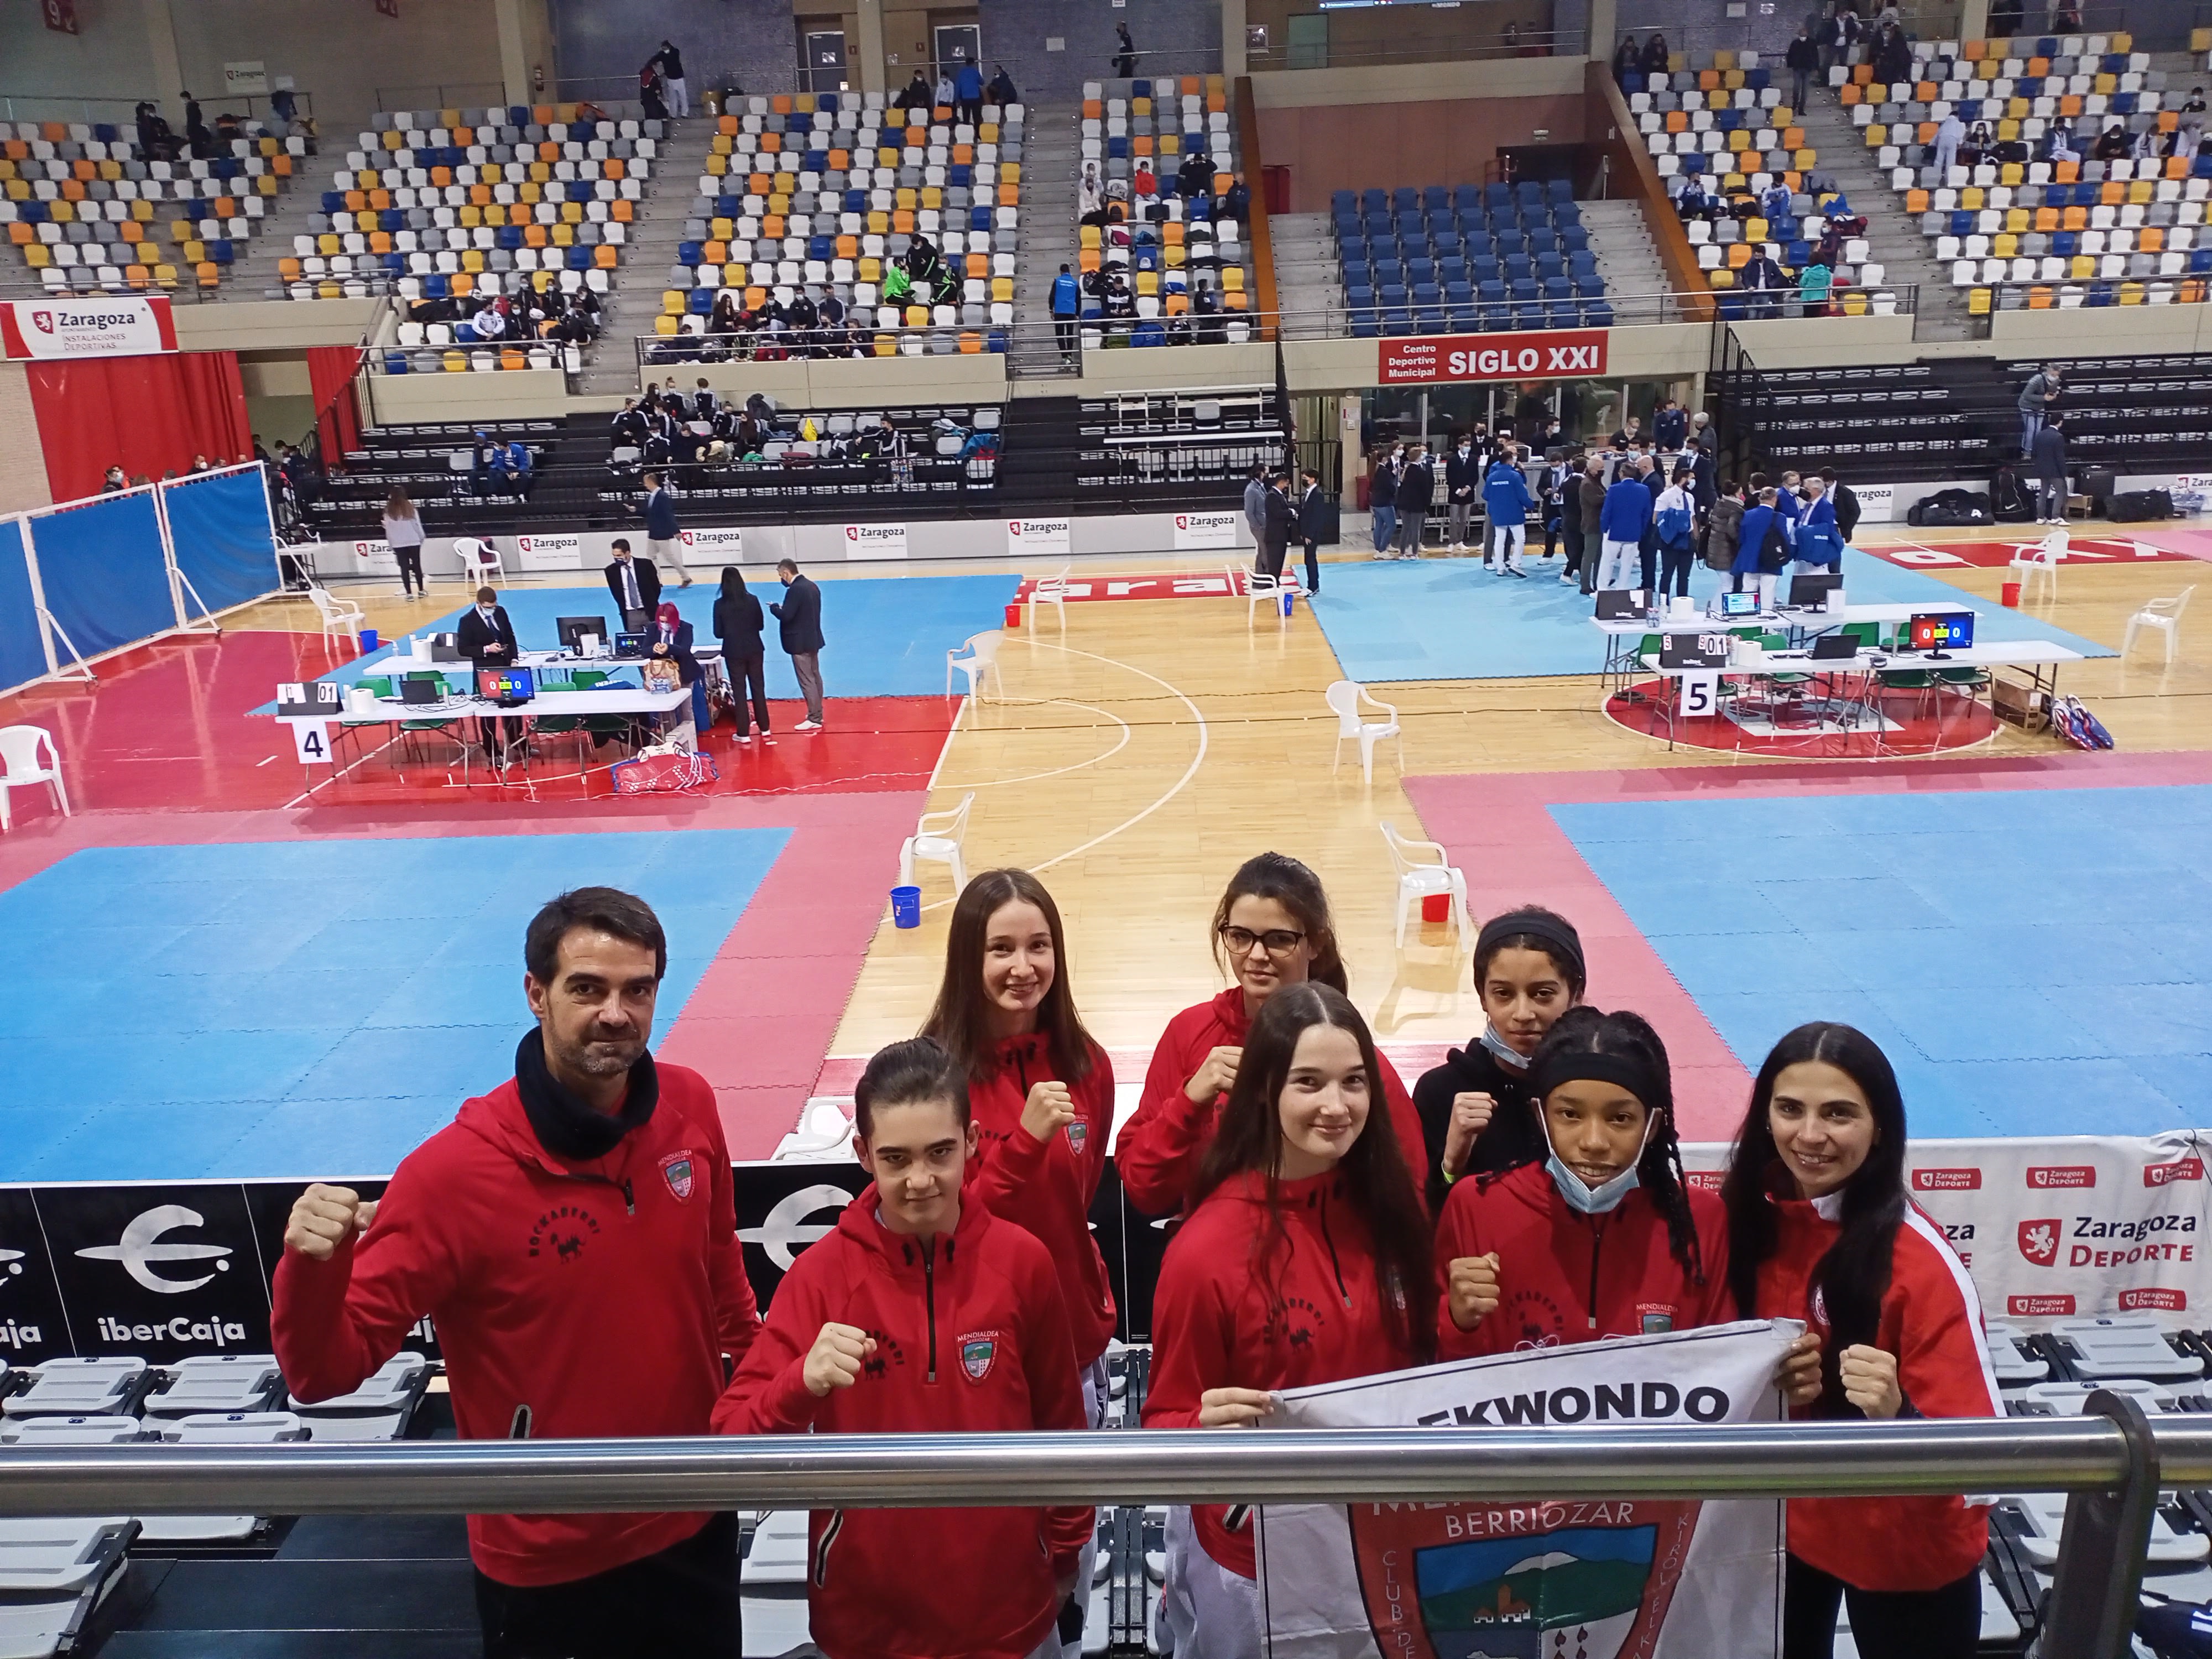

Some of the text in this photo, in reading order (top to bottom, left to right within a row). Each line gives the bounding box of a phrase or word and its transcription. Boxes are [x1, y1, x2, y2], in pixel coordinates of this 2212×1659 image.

[58, 312, 135, 330] Zaragoza
[62, 333, 126, 342] INSTALACIONES
[64, 342, 117, 351] DEPORTIVAS
[1403, 345, 1436, 354] Centro
[1389, 356, 1436, 367] Deportivo
[1448, 345, 1599, 375] SIGLO XXI
[1389, 367, 1436, 378] Municipal
[1853, 490, 1891, 501] aragoza
[1023, 522, 1068, 534] Zaragoza
[1190, 517, 1234, 528] Zaragoza
[695, 533, 740, 544] Zaragoza
[860, 528, 905, 539] Zaragoza
[370, 544, 392, 552] Zara
[534, 538, 577, 549] Zaragoza
[1922, 628, 1931, 639] 0
[1953, 627, 1960, 638] 0
[1665, 637, 1670, 648] 5
[1707, 637, 1724, 654] 01
[489, 681, 497, 690] 0
[515, 680, 521, 690] 0
[319, 686, 333, 701] 01
[1688, 682, 1708, 711] 5
[304, 731, 324, 758] 4
[658, 1150, 692, 1167] MENDIALDEA
[1935, 1172, 1971, 1181] Zaragoza
[2049, 1170, 2085, 1179] Zaragoza
[2073, 1215, 2197, 1242] Zaragoza
[2069, 1243, 2194, 1267] DEPORTE
[2137, 1299, 2174, 1307] DEPORTE
[97, 1316, 246, 1347] iberCaja
[957, 1331, 999, 1343] MENDIALDEA
[1446, 1502, 1634, 1538] BERRIOZAR
